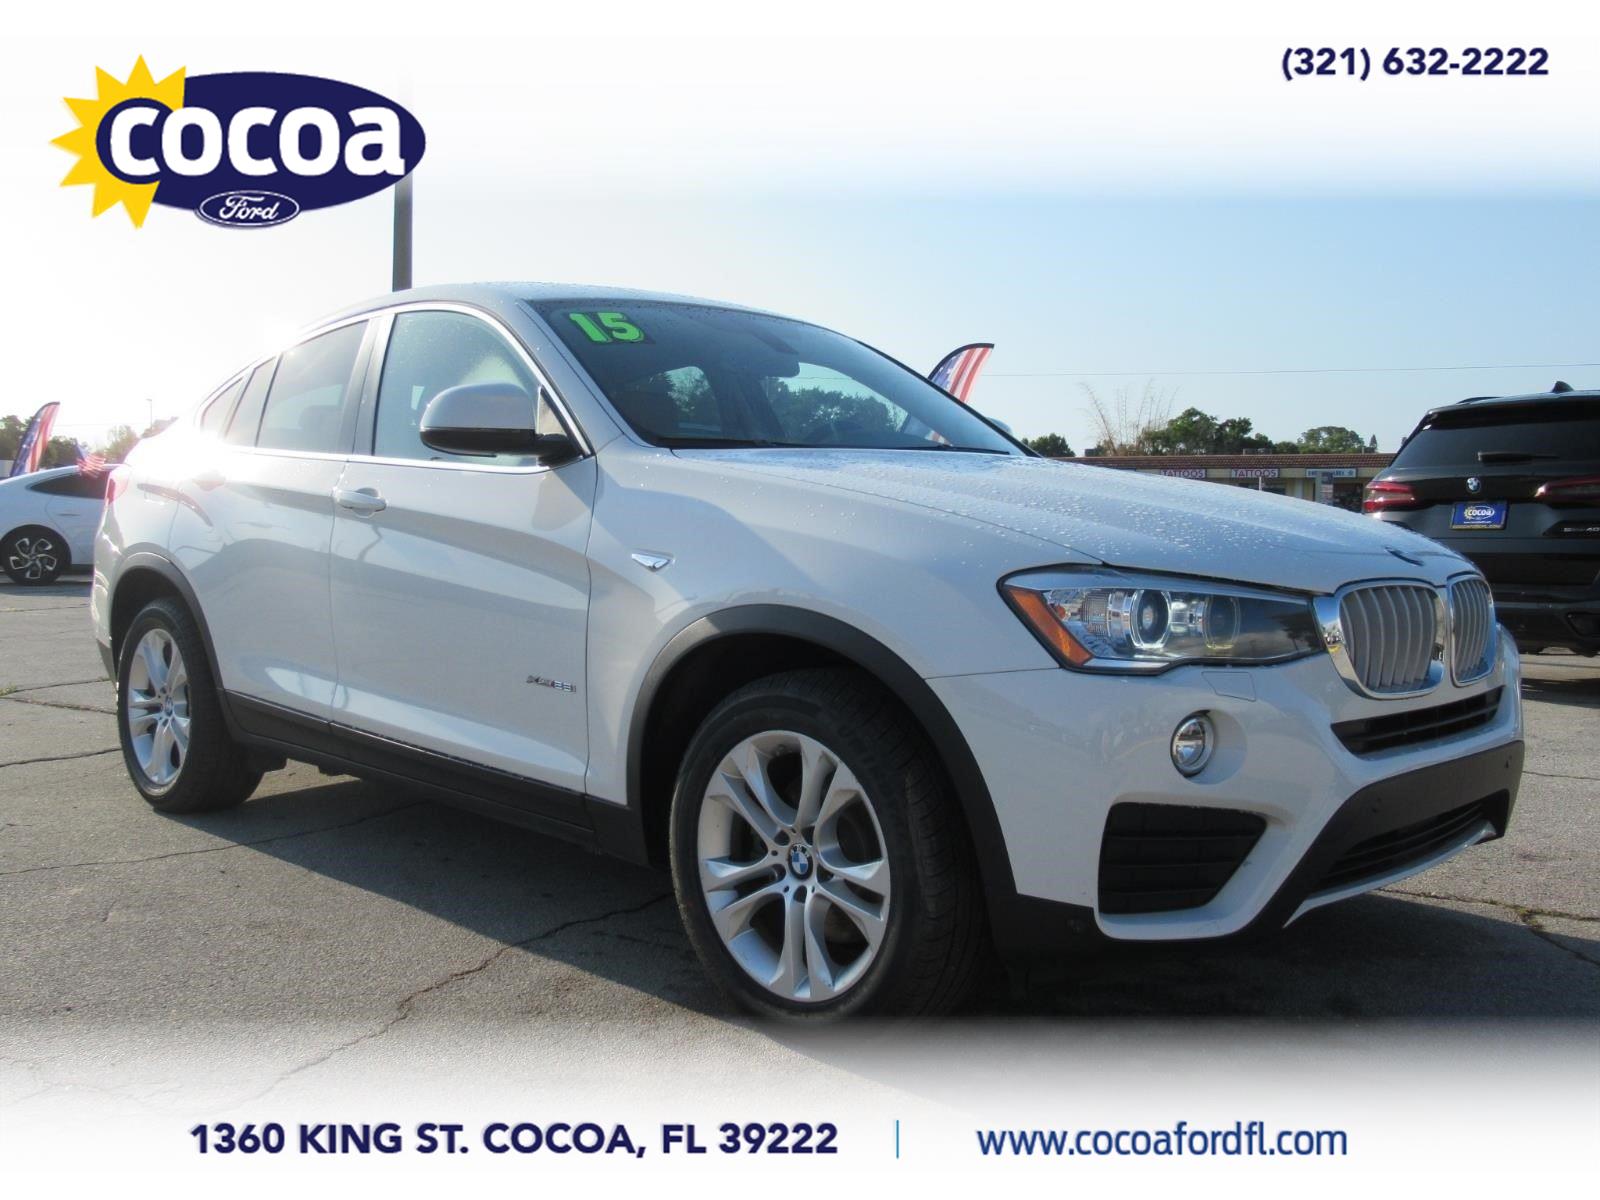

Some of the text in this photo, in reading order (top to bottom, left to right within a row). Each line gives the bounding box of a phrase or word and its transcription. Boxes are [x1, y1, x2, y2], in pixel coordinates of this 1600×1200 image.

[569, 312, 644, 342] 15
[1162, 469, 1204, 478] TATTOOS
[1234, 468, 1277, 478] TATTOOS
